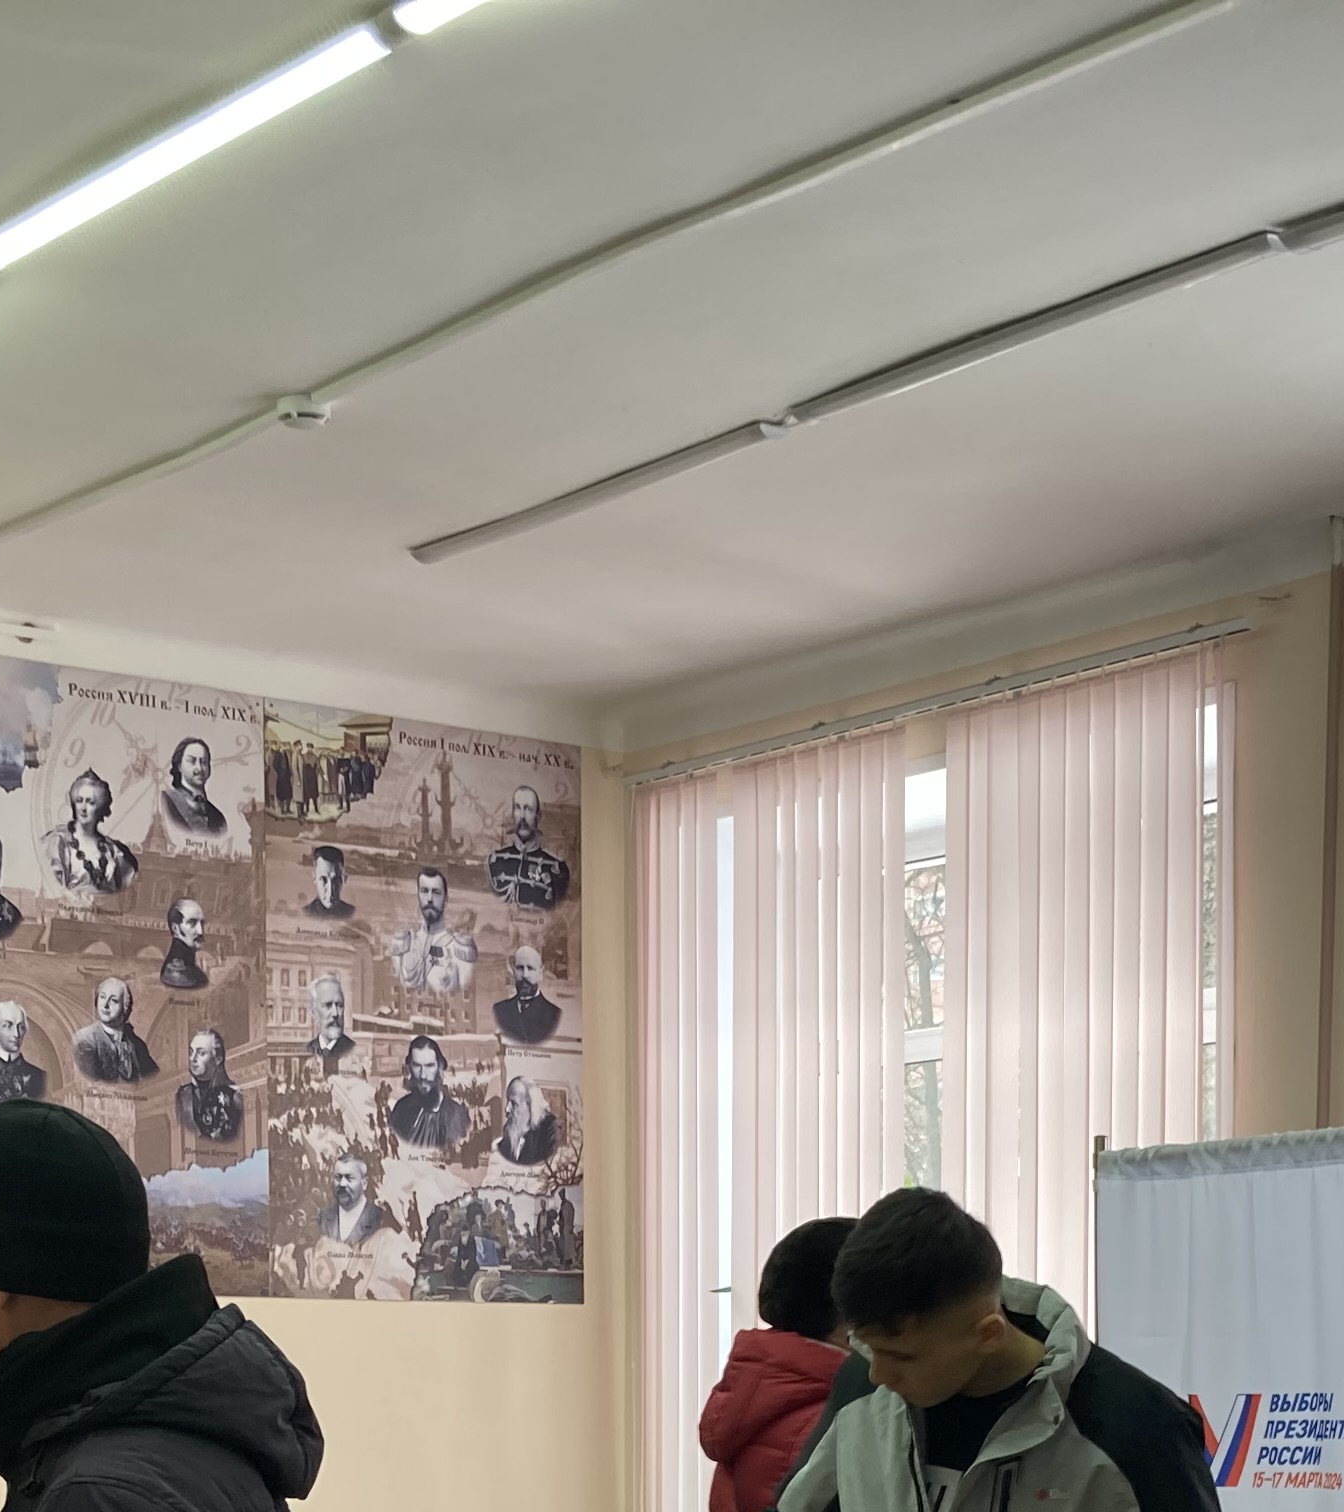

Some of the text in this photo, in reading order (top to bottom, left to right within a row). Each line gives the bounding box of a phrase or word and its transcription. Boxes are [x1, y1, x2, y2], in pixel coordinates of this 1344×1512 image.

[67, 682, 114, 702] Россия
[117, 689, 156, 708] XVIII
[160, 701, 172, 711] в.
[220, 706, 247, 722] XIX
[398, 731, 437, 749] Россия
[473, 742, 496, 758] XIX
[544, 753, 562, 768] XX
[1269, 1392, 1334, 1413] ВЫБОРЫ
[1257, 1446, 1322, 1466] РОССИИ
[1284, 1472, 1323, 1489] МАРТА
[1323, 1472, 1343, 1490] 2024
